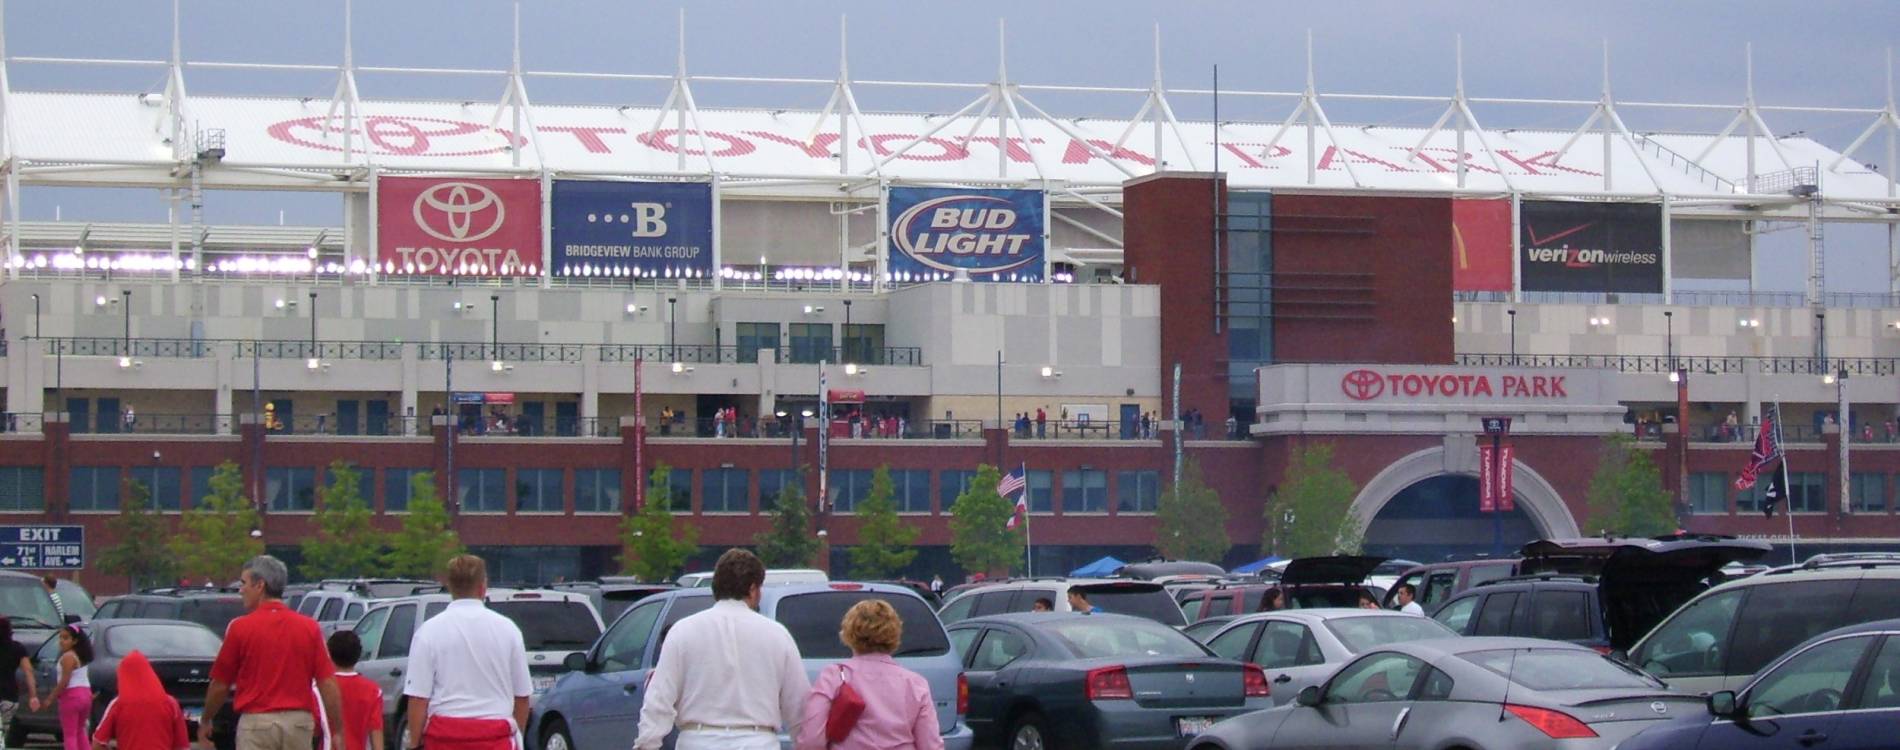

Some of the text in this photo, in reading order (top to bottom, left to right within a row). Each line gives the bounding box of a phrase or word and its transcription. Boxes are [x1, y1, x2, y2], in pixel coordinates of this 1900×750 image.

[536, 126, 1602, 176] TOYOTA PARK
[931, 208, 1016, 229] BUD
[566, 245, 700, 258] BRIDGEVIEW BANK GROUP
[914, 233, 1030, 254] LIGHT
[396, 247, 524, 272] TOYOTA
[1387, 374, 1567, 397] TOYOTA PARK
[20, 528, 61, 541] EXIT
[44, 545, 80, 556] HARLEM
[21, 556, 36, 567] ST.
[44, 556, 64, 567] AVE.
